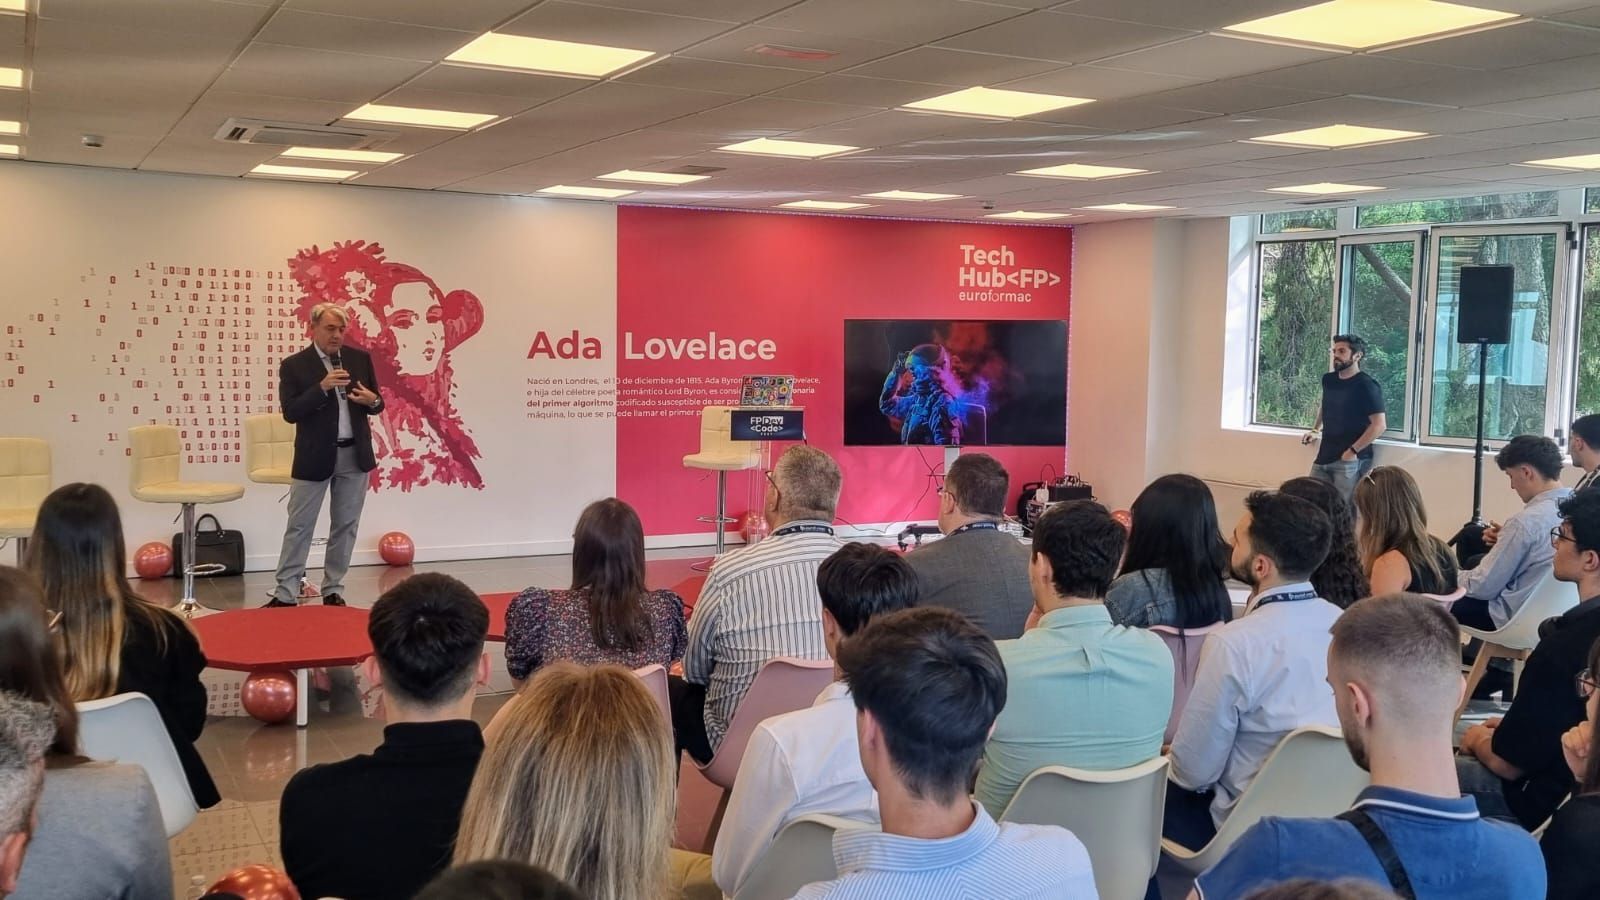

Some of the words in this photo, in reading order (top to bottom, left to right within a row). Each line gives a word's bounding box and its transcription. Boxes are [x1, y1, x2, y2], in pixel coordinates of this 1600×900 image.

[959, 244, 1015, 266] Tech
[959, 266, 1061, 289] Hub<FP>
[958, 289, 1032, 303] euroformac
[527, 330, 602, 360] Ada
[624, 331, 777, 361] Lovelace
[527, 377, 551, 385] Nació
[565, 377, 599, 386] Londres,
[603, 377, 611, 385] el
[622, 376, 633, 385] de
[634, 376, 674, 385] diciembre
[675, 376, 685, 385] de
[704, 376, 720, 384] Ada
[792, 376, 821, 384] ovelace,
[534, 389, 549, 398] hija
[551, 388, 564, 396] del
[565, 388, 596, 396] célebre
[597, 388, 621, 397] poeta
[622, 387, 663, 395] romántico
[664, 387, 682, 395] Lord
[683, 387, 708, 396] Byron,
[792, 386, 815, 394] onaria
[526, 399, 540, 407] del
[542, 400, 571, 408] primer
[573, 398, 614, 408] algoritmo
[616, 398, 656, 406] codificado
[657, 398, 701, 408] susceptible
[527, 410, 566, 419] máquina,
[567, 410, 575, 418] lo
[577, 411, 593, 419] que
[606, 409, 632, 419] puede
[633, 409, 659, 417] llamar
[659, 409, 667, 417] el
[668, 409, 694, 418] primer
